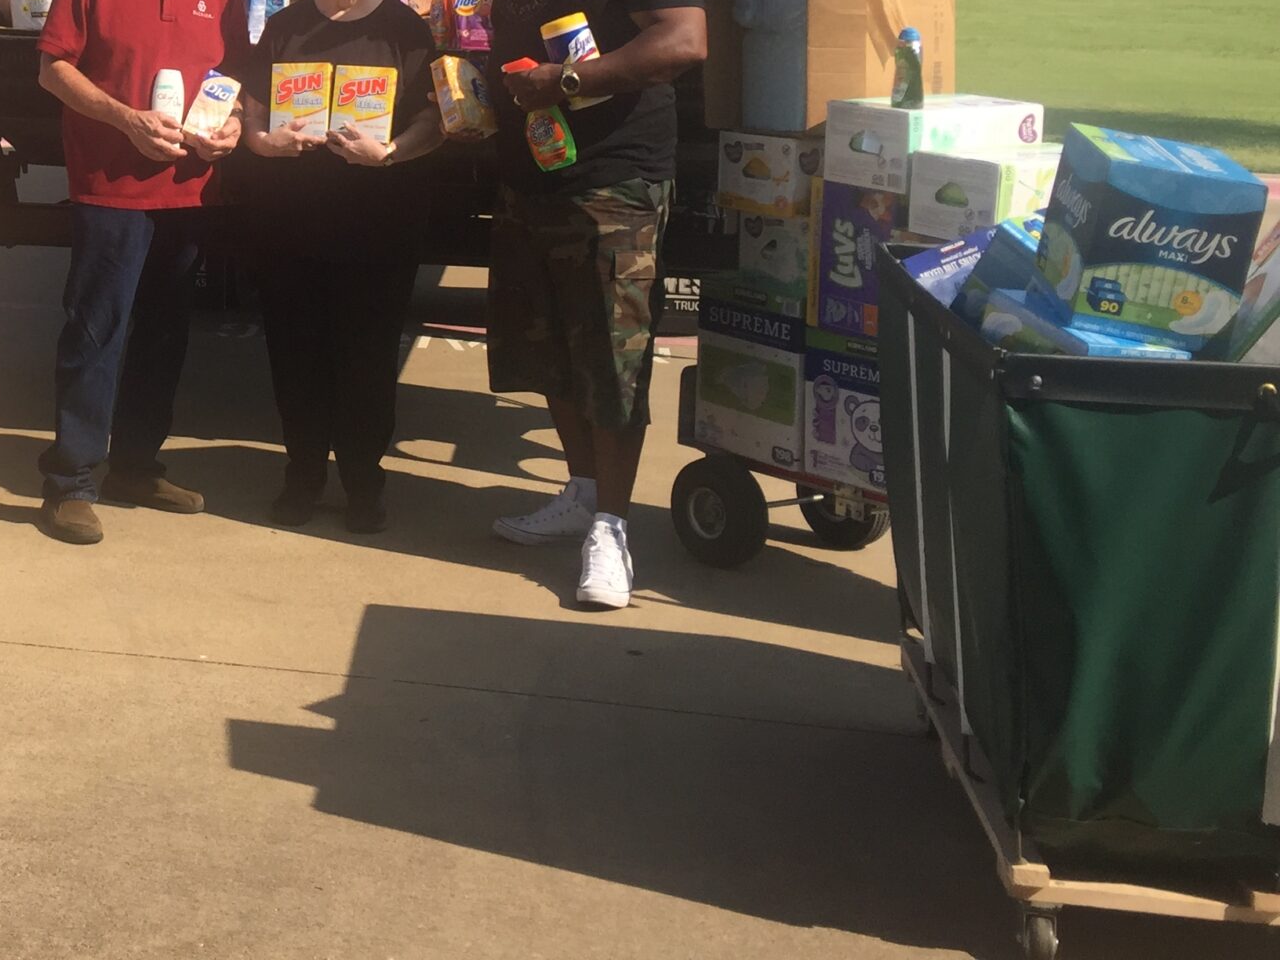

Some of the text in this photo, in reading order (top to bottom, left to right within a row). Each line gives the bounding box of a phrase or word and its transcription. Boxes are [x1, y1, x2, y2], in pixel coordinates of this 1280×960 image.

[204, 82, 235, 102] Dial
[276, 71, 323, 105] SUN
[337, 77, 388, 107] SUN
[1108, 209, 1238, 265] always
[829, 218, 863, 288] Luvs
[1158, 248, 1188, 263] MAXI
[674, 300, 700, 312] TRUC
[1099, 300, 1119, 314] 90
[709, 305, 792, 341] SUPREME
[823, 357, 880, 384] SUPREM
